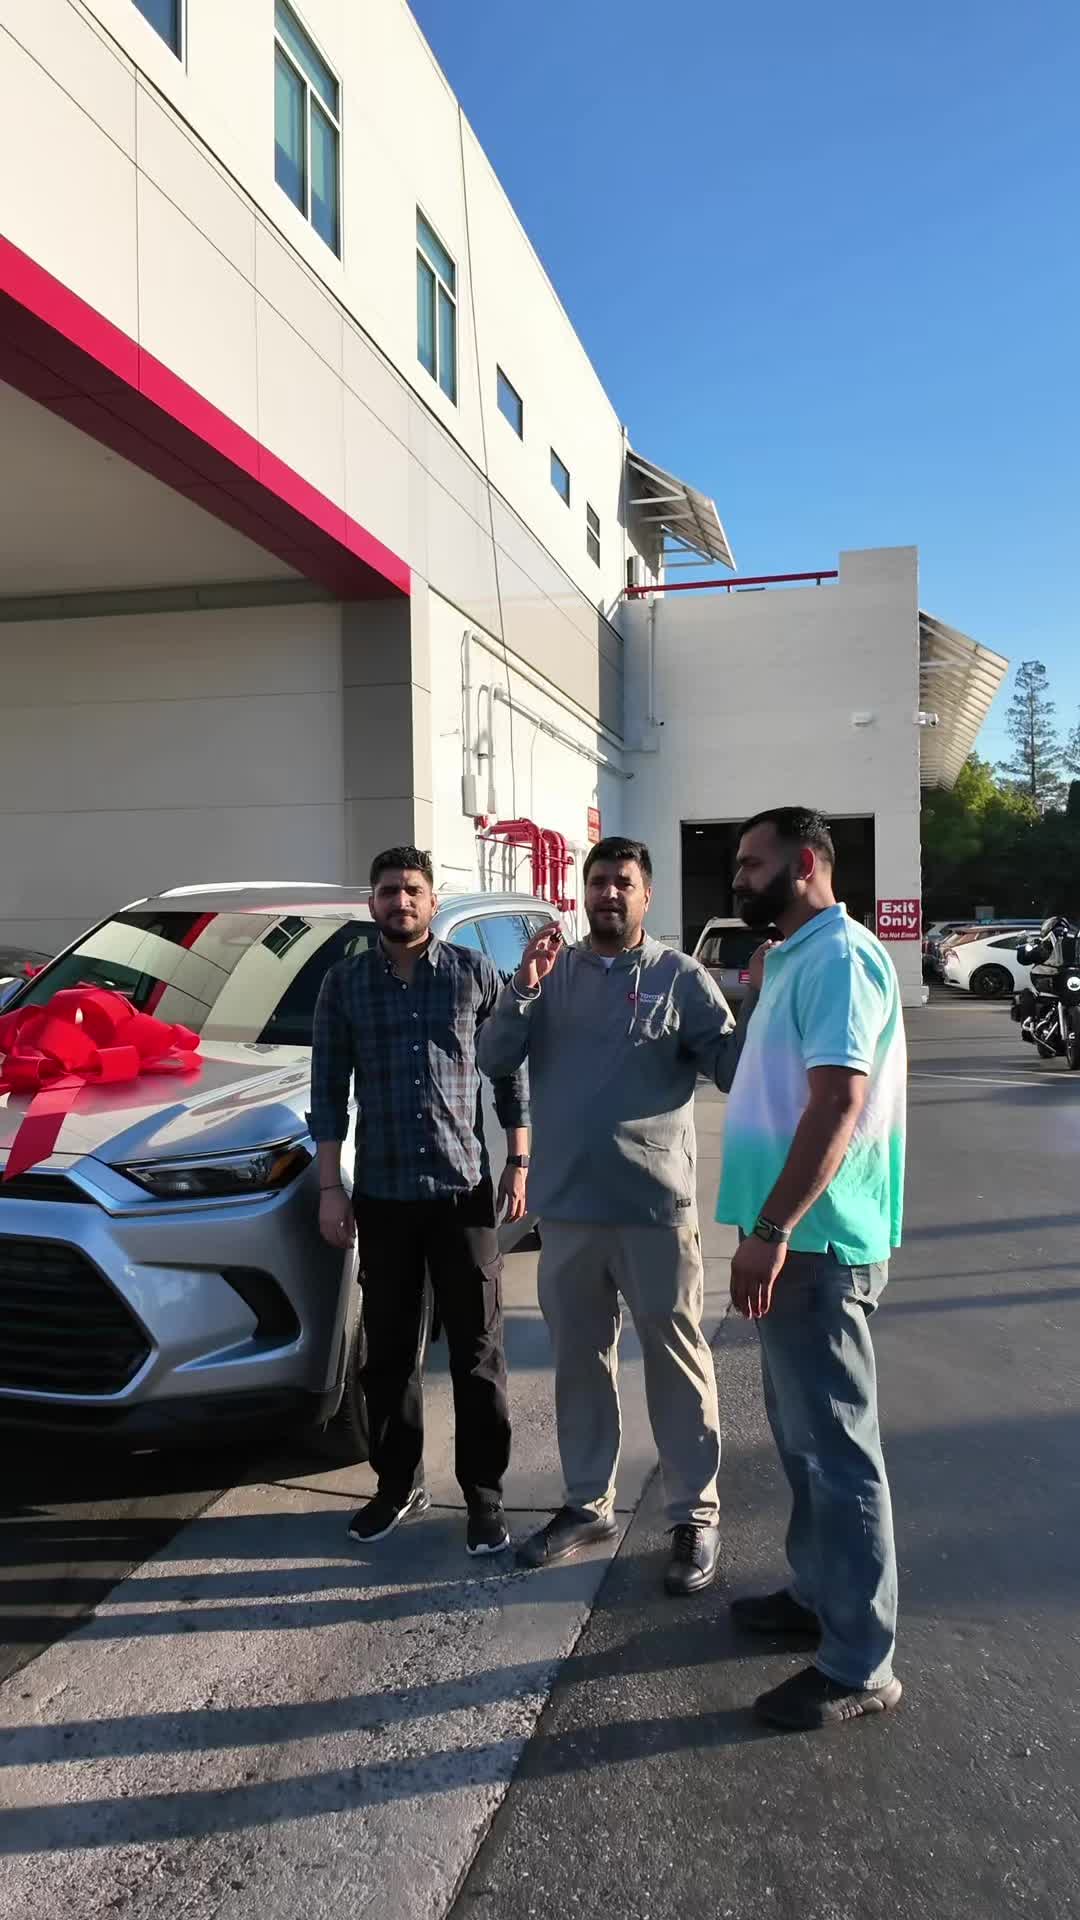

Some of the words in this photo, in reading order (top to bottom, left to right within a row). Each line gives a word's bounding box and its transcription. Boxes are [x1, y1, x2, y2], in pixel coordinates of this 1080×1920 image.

[881, 901, 915, 913] Exit
[879, 915, 917, 929] Only
[640, 992, 665, 1000] TOYOT
